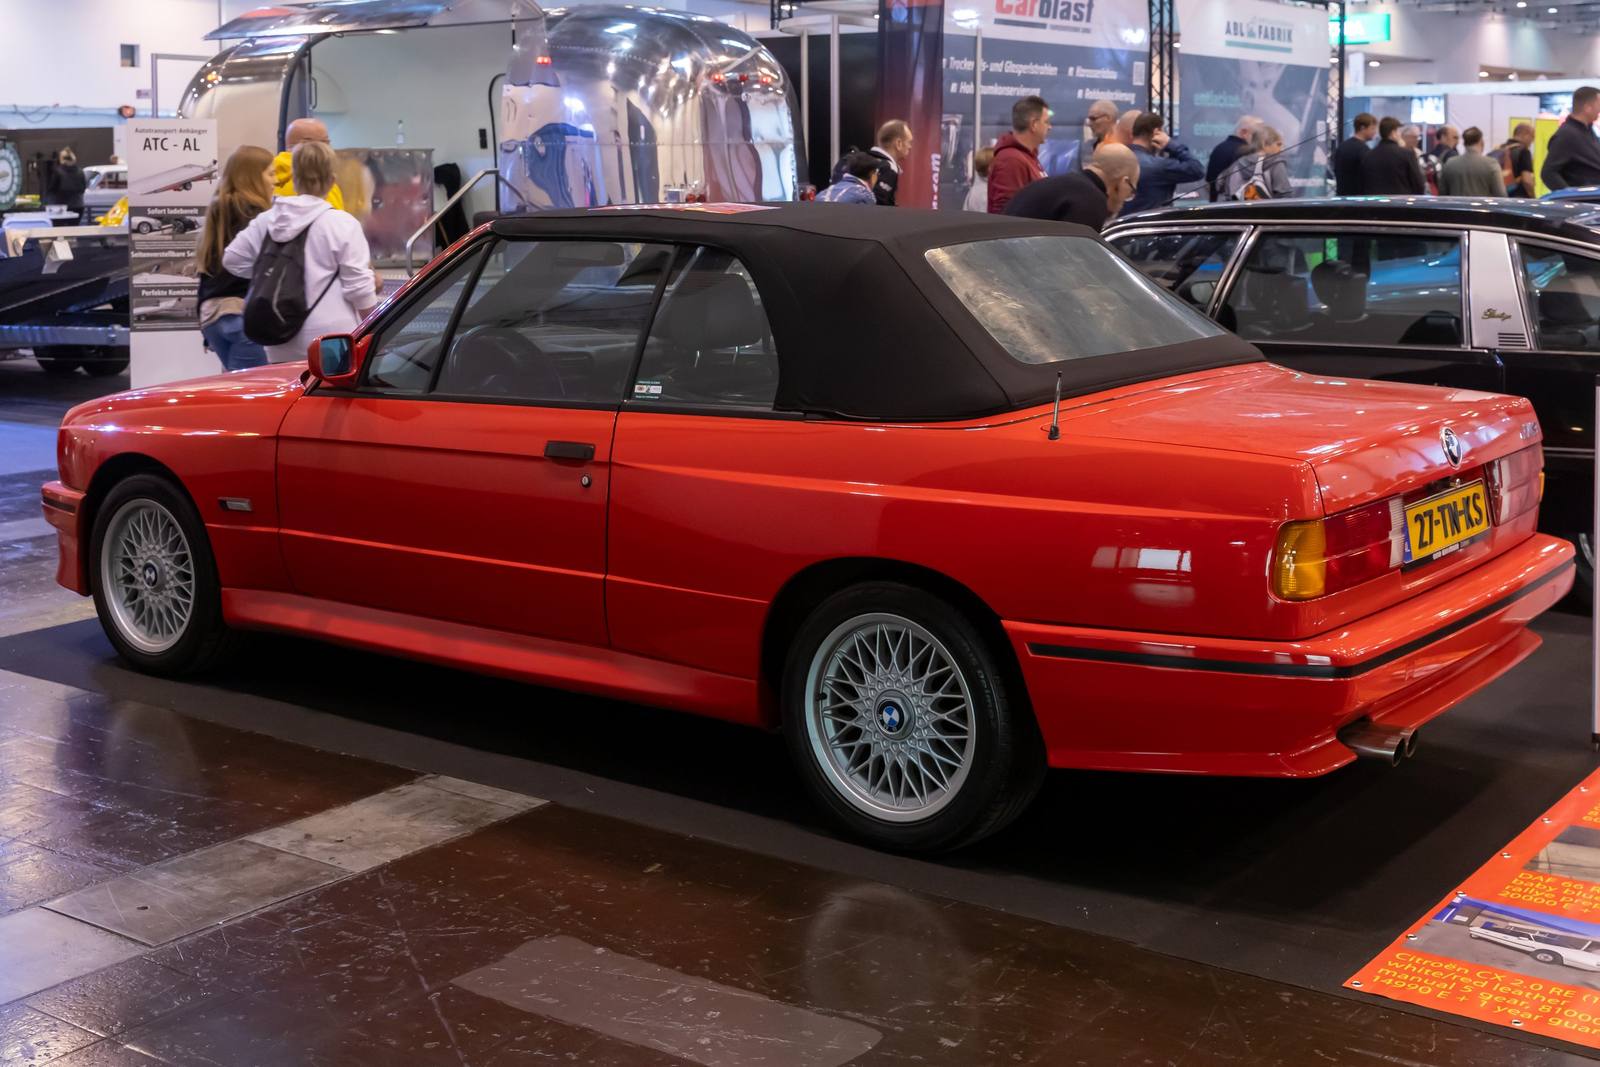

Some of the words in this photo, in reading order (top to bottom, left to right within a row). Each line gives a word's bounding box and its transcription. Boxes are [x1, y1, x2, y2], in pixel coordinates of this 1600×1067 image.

[995, 0, 1094, 23] Carblast
[1258, 25, 1293, 43] FABRIK
[143, 138, 168, 151] ATC
[183, 138, 201, 151] AL
[141, 289, 168, 297] Perfekte
[1414, 492, 1483, 550] 27-TN-KS
[1512, 878, 1558, 892] baby
[1518, 872, 1556, 882] DAF
[1497, 890, 1558, 906] 20000
[1505, 885, 1556, 898] rallye
[1387, 960, 1488, 988] white/red
[1492, 983, 1570, 1006] leather
[1395, 952, 1470, 974] Citroën
[1476, 970, 1507, 982] CX
[1510, 979, 1544, 991] 2.0
[1549, 986, 1577, 998] RE
[1373, 975, 1432, 995] 14990
[1436, 990, 1451, 999] E
[1480, 1000, 1488, 1008] 1
[1493, 1005, 1544, 1021] year
[1377, 968, 1456, 990] manual
[1460, 985, 1473, 993] 5
[1479, 991, 1531, 1010] gear,
